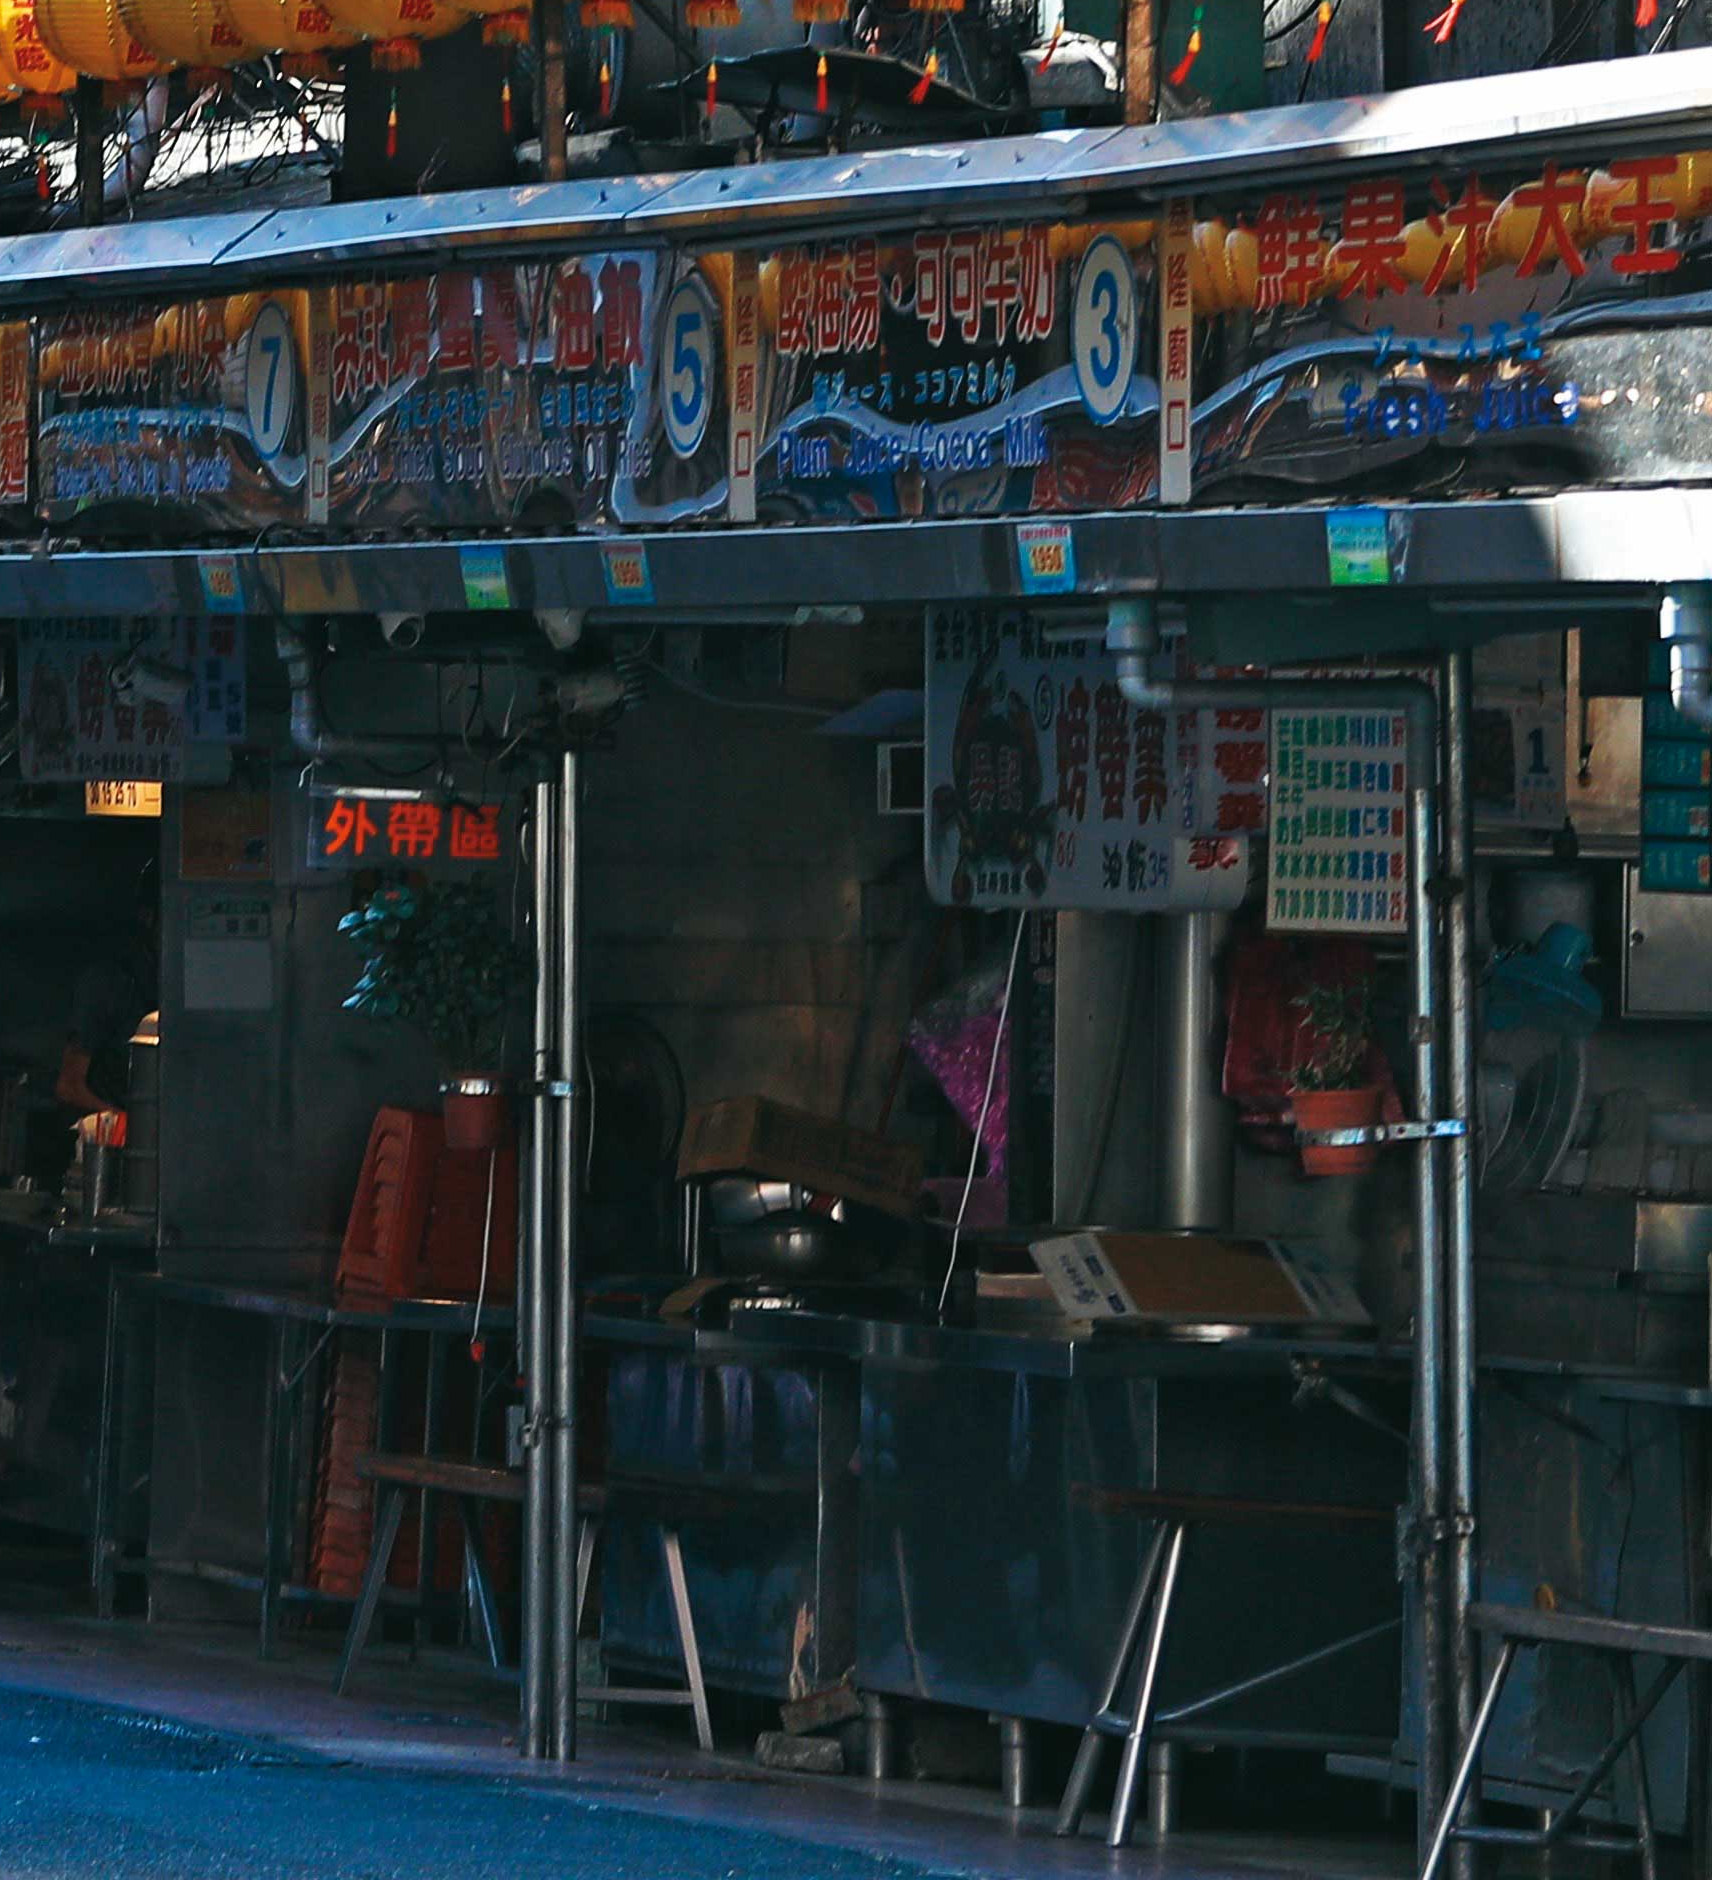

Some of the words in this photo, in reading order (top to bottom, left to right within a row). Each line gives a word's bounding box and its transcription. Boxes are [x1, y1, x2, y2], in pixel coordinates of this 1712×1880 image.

[1255, 156, 1684, 312] 鮮果汁大王
[260, 337, 282, 434] 7
[672, 312, 702, 426] 5
[1088, 269, 1120, 389] 3
[322, 797, 503, 860] 外帶區
